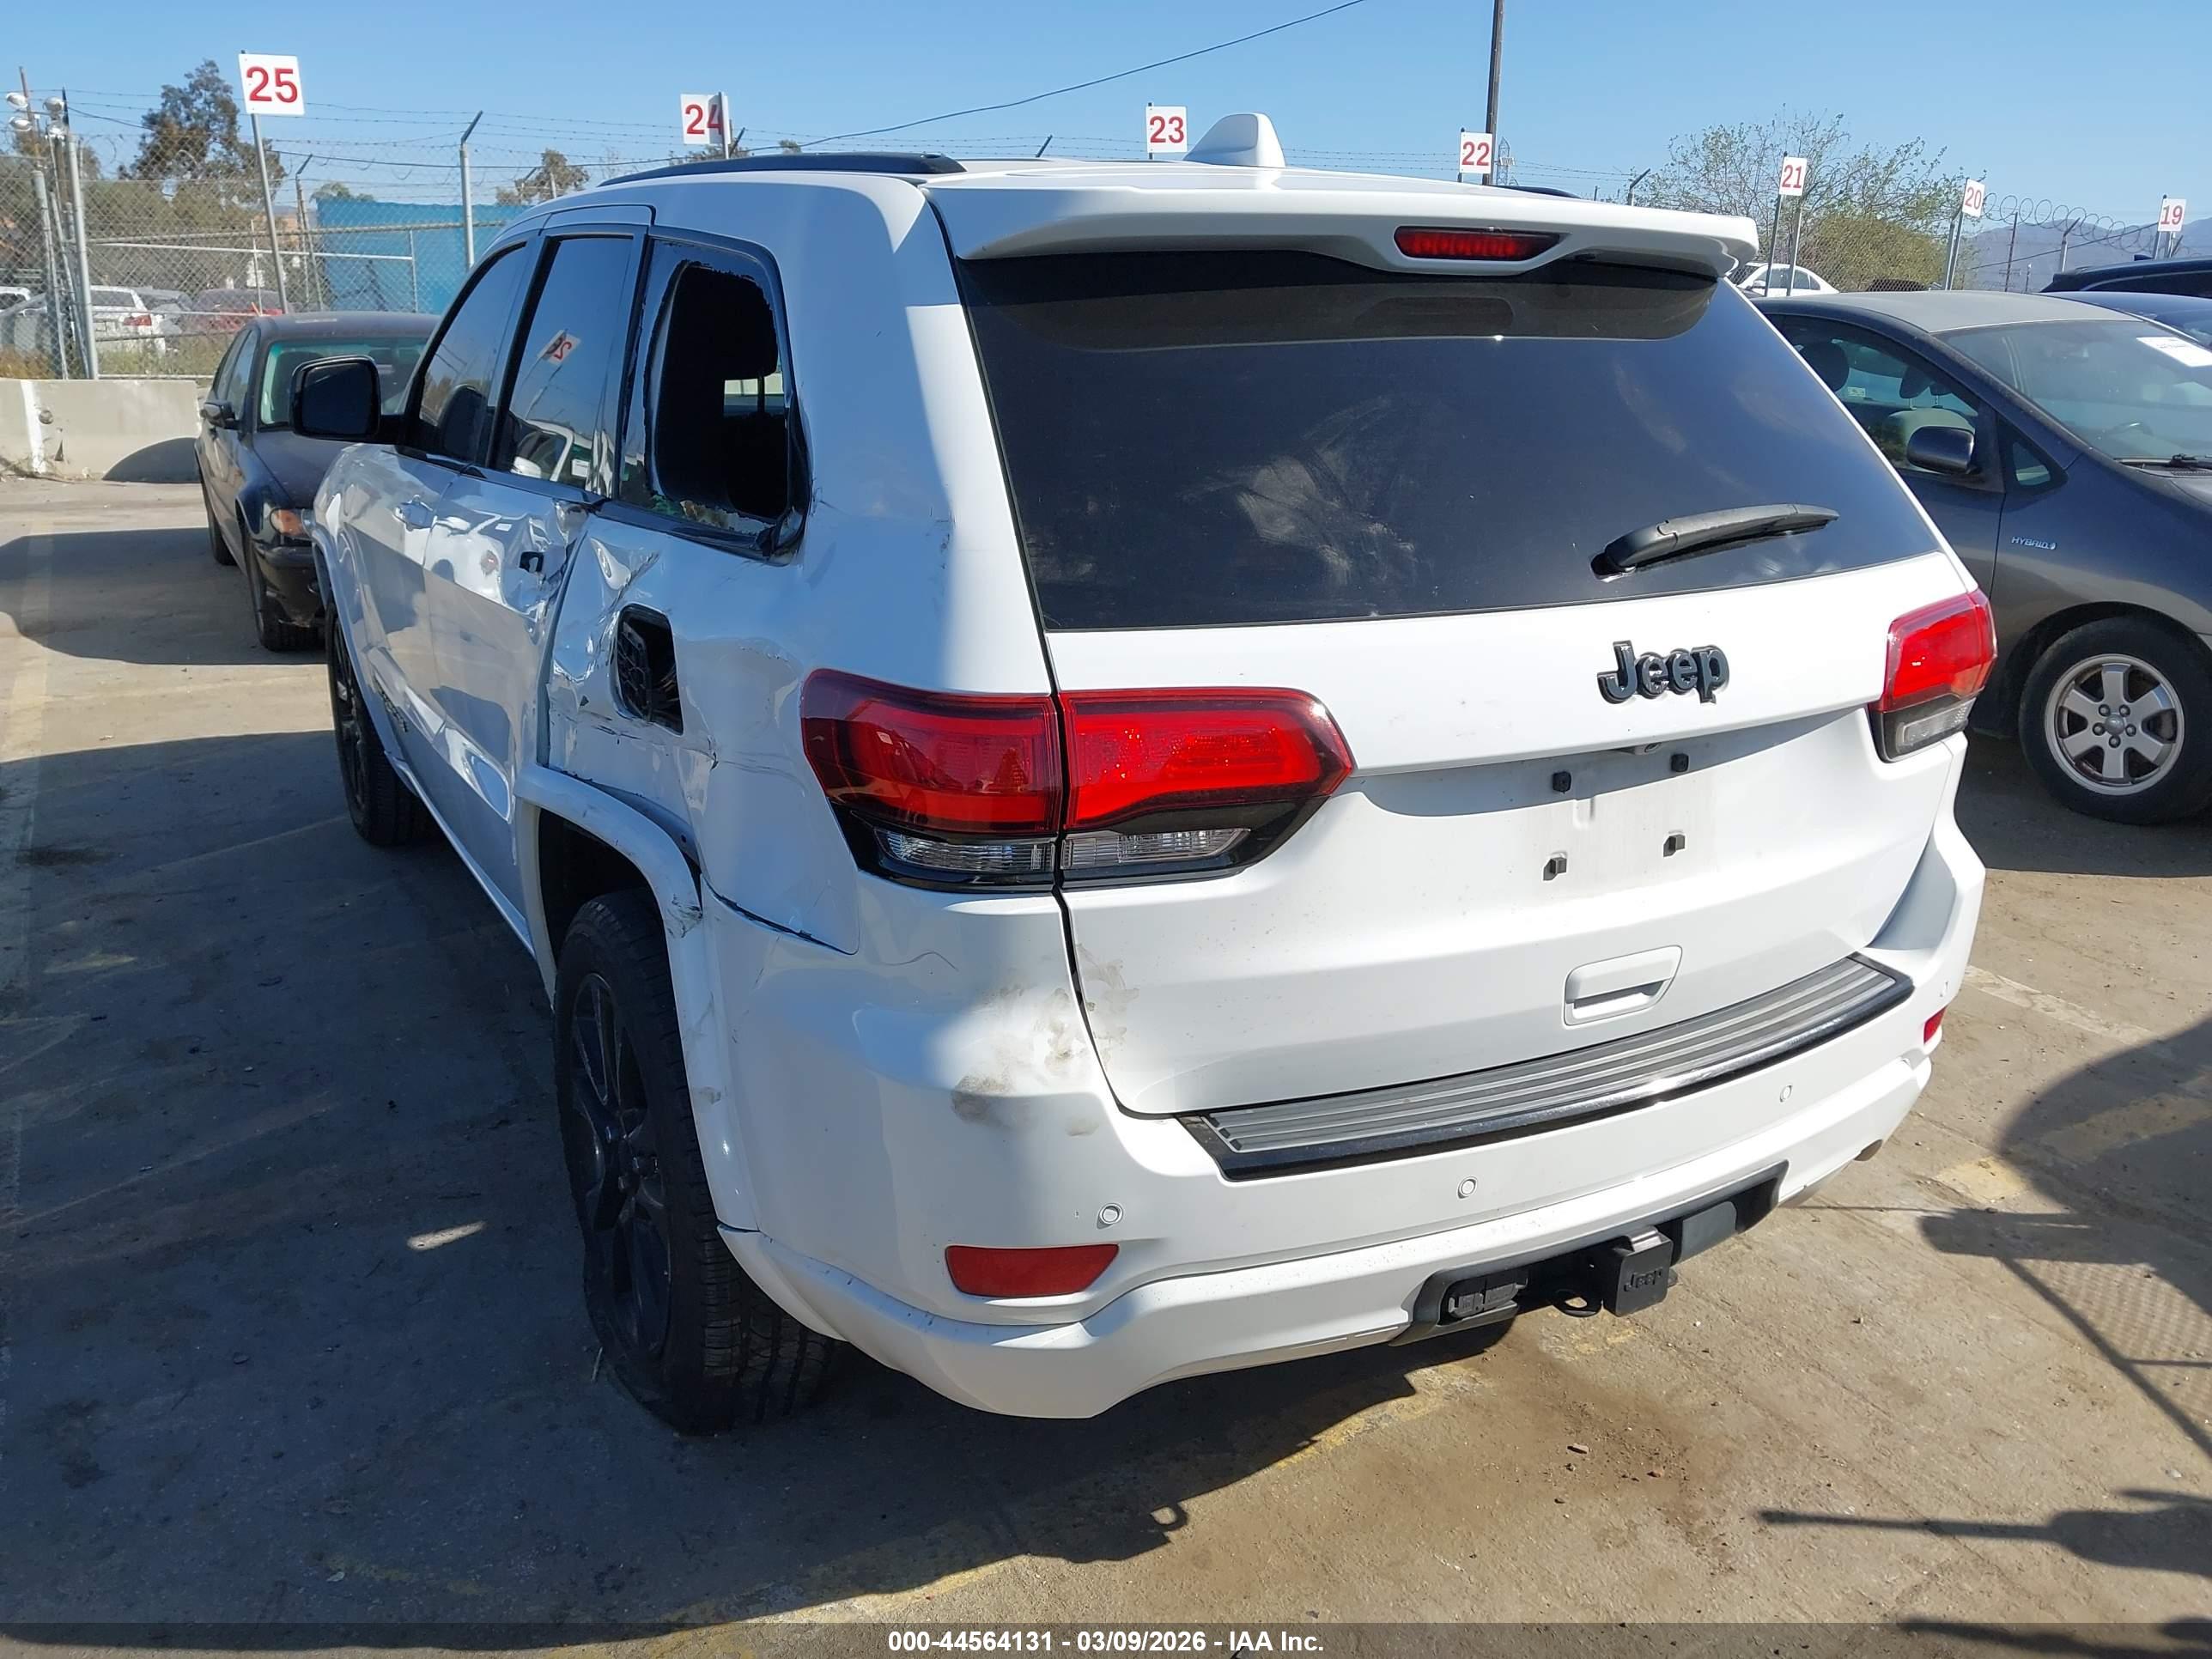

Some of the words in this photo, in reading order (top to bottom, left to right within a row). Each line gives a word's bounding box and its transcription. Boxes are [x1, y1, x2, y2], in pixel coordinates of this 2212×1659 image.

[246, 66, 298, 103] 25
[685, 104, 724, 136] 24
[1150, 115, 1184, 143] 23
[1462, 141, 1490, 166] 22
[1782, 164, 1802, 188] 21
[1965, 186, 1982, 210] 20
[2160, 204, 2183, 225] 19
[2011, 536, 2050, 550] HYBRID
[1597, 640, 1729, 704] Jeep
[1623, 1267, 1663, 1291] Jeep
